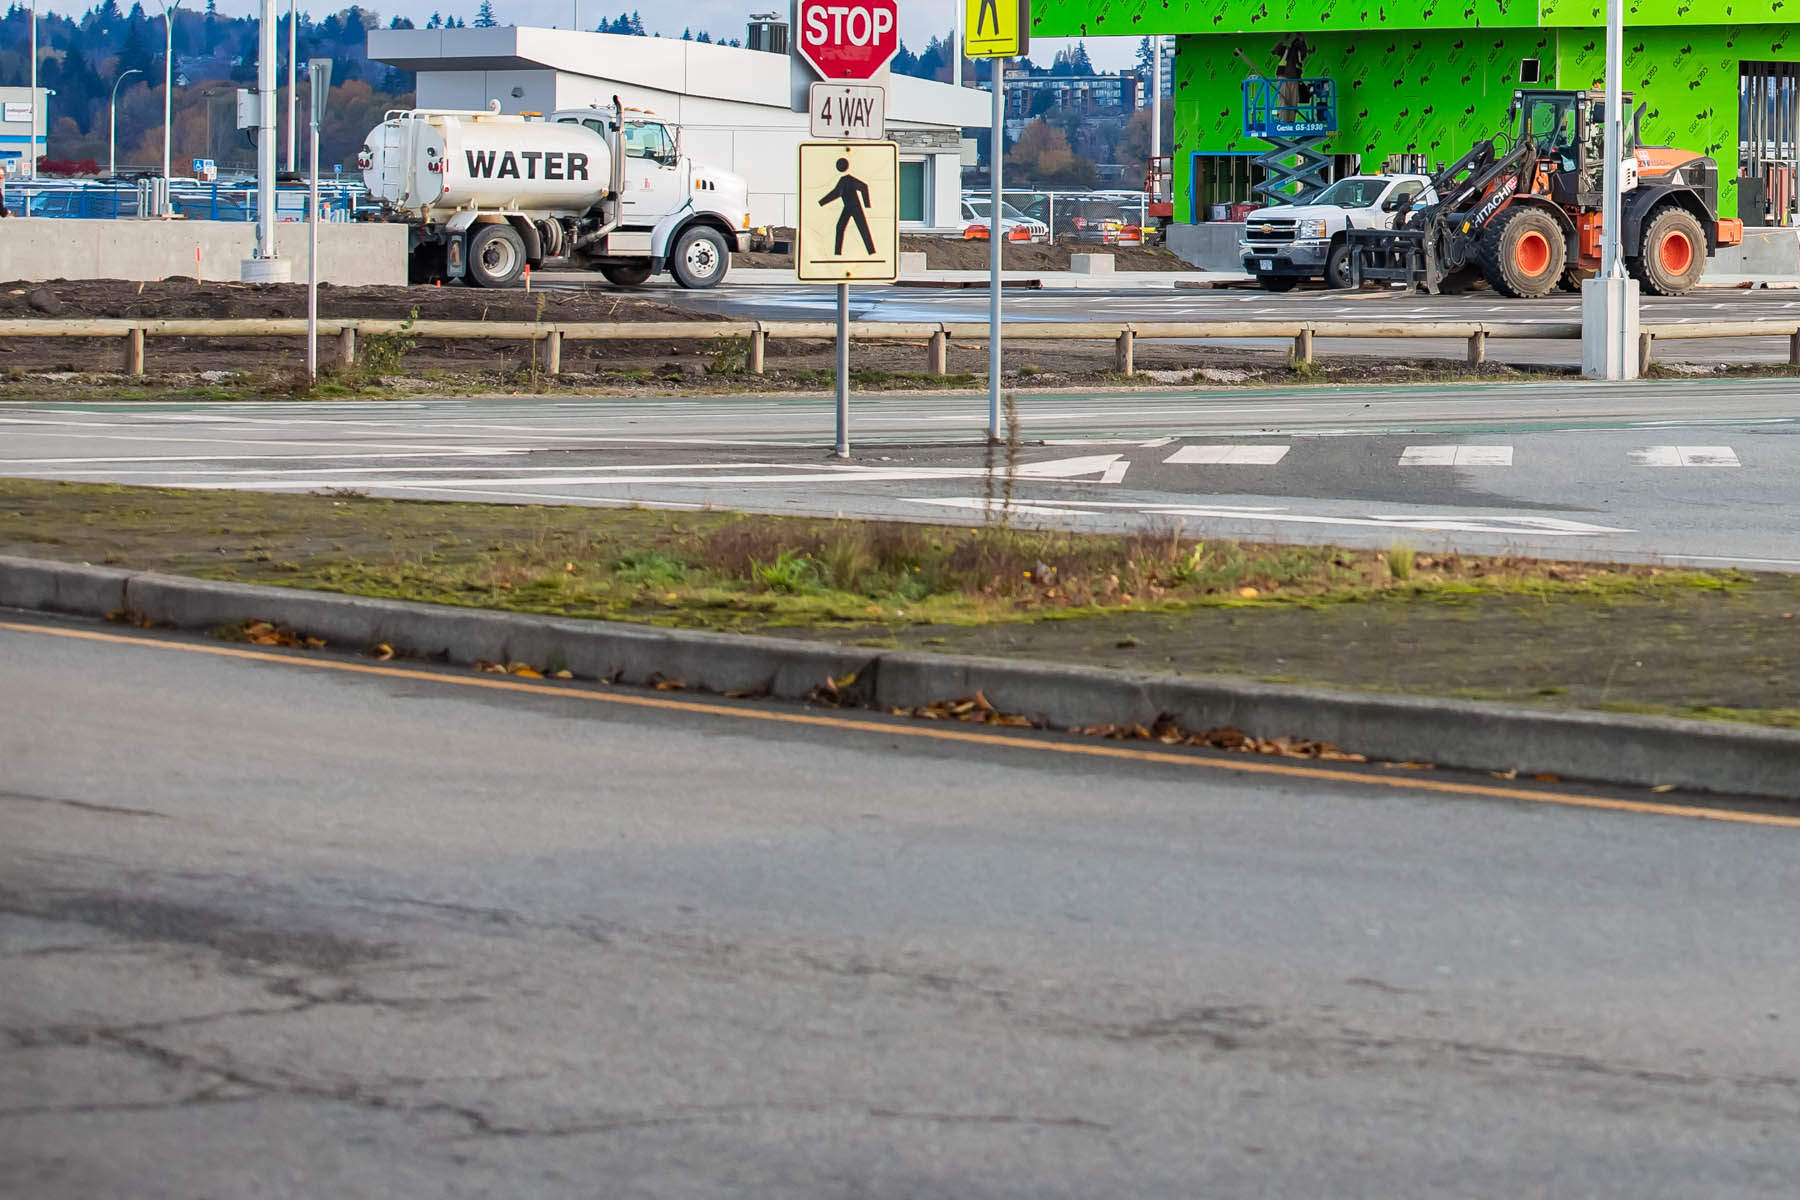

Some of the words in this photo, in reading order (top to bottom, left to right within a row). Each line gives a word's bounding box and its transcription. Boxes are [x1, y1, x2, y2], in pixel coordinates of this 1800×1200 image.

[805, 4, 894, 47] STOP
[1575, 51, 1586, 65] CGC
[1625, 52, 1636, 66] CGC
[1673, 55, 1683, 69] CGC
[1647, 65, 1658, 80] CGC
[1697, 67, 1708, 81] CGC
[820, 97, 832, 127] 4
[838, 97, 875, 128] WAY
[1689, 120, 1699, 133] CGC
[1665, 131, 1676, 145] CGC
[465, 150, 590, 181] WATER
